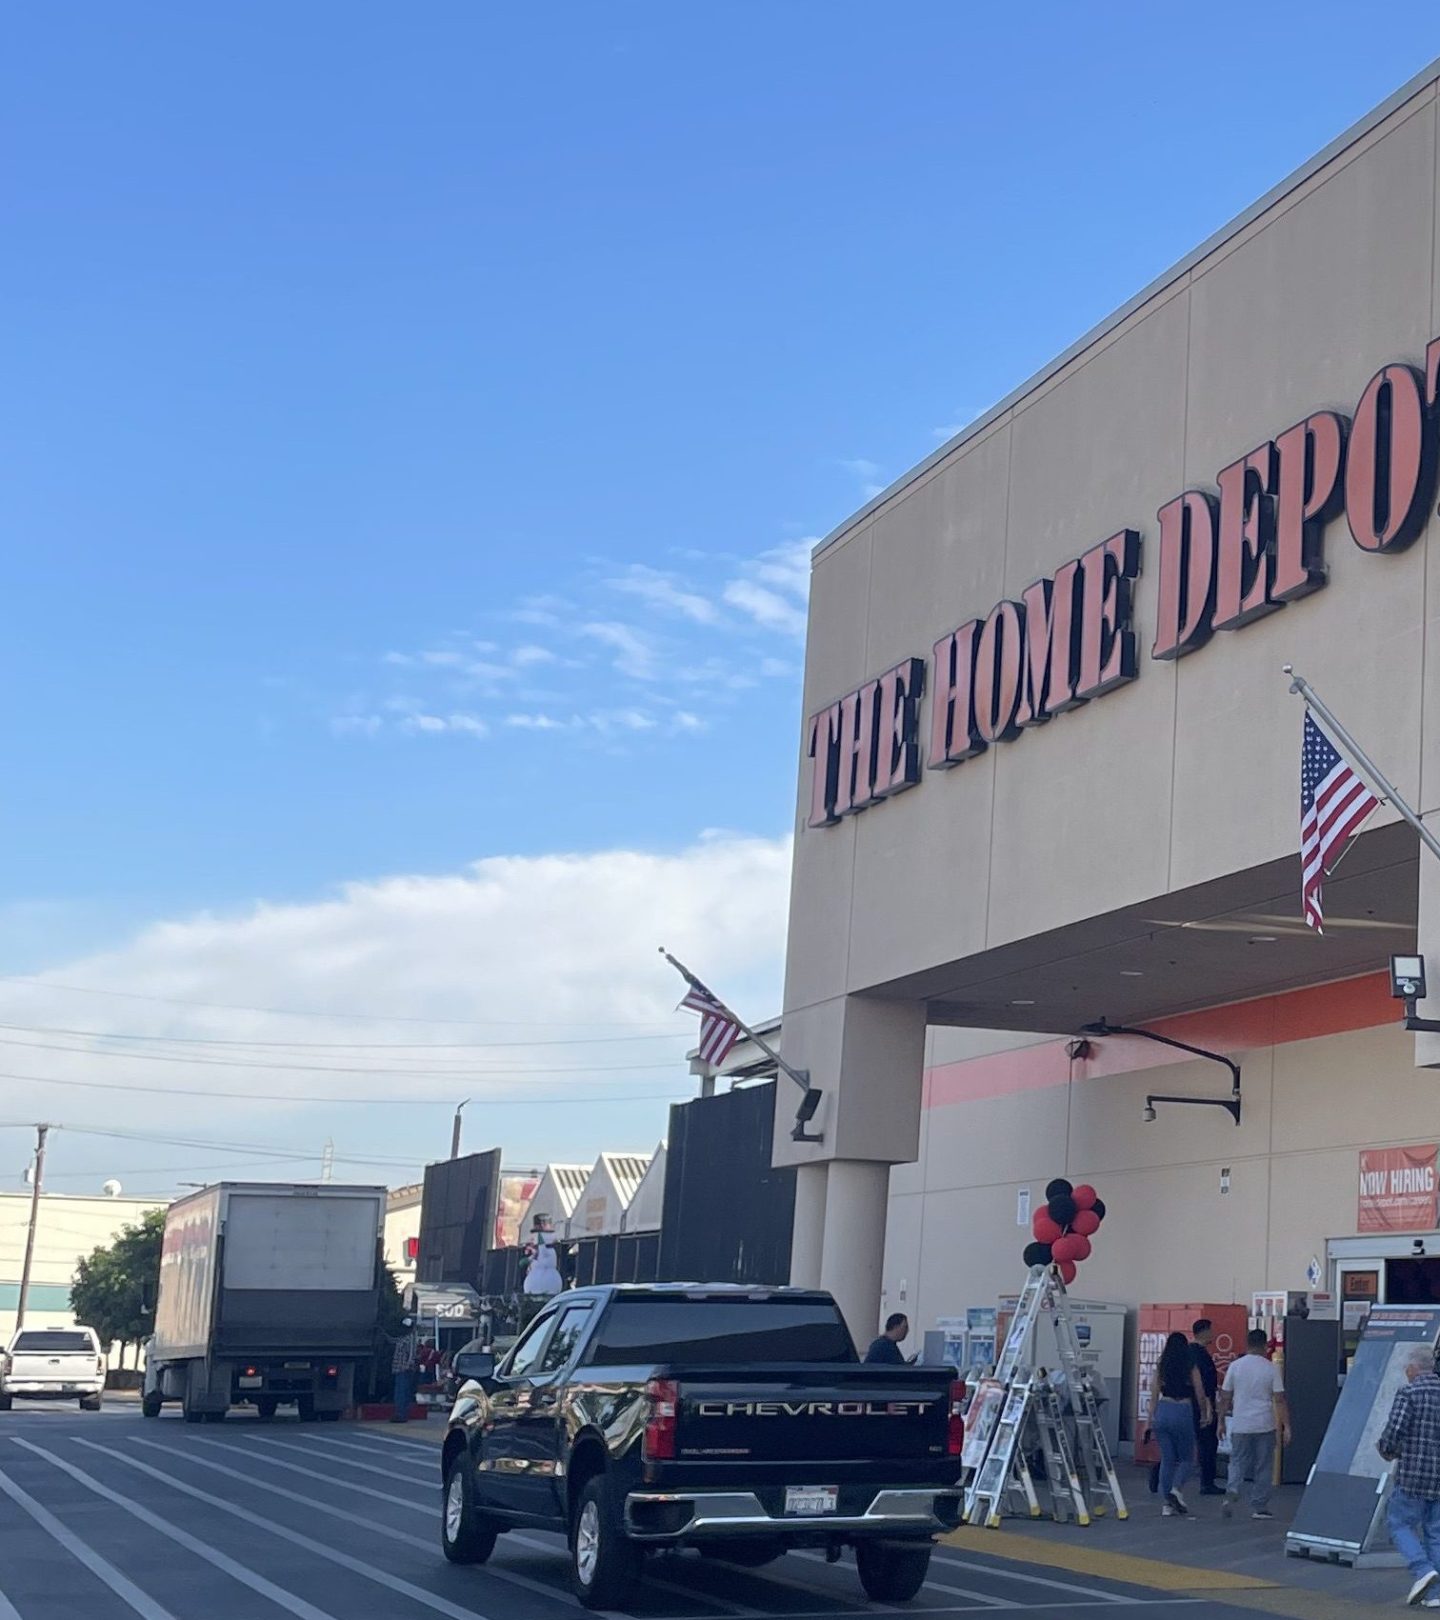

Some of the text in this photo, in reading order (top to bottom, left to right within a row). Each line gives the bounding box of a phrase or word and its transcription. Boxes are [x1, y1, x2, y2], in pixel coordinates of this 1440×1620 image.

[808, 656, 924, 828] THE
[928, 528, 1142, 771] HOME
[1360, 1166, 1434, 1196] NOW HIRING
[700, 1402, 933, 1416] CHEVROLET
